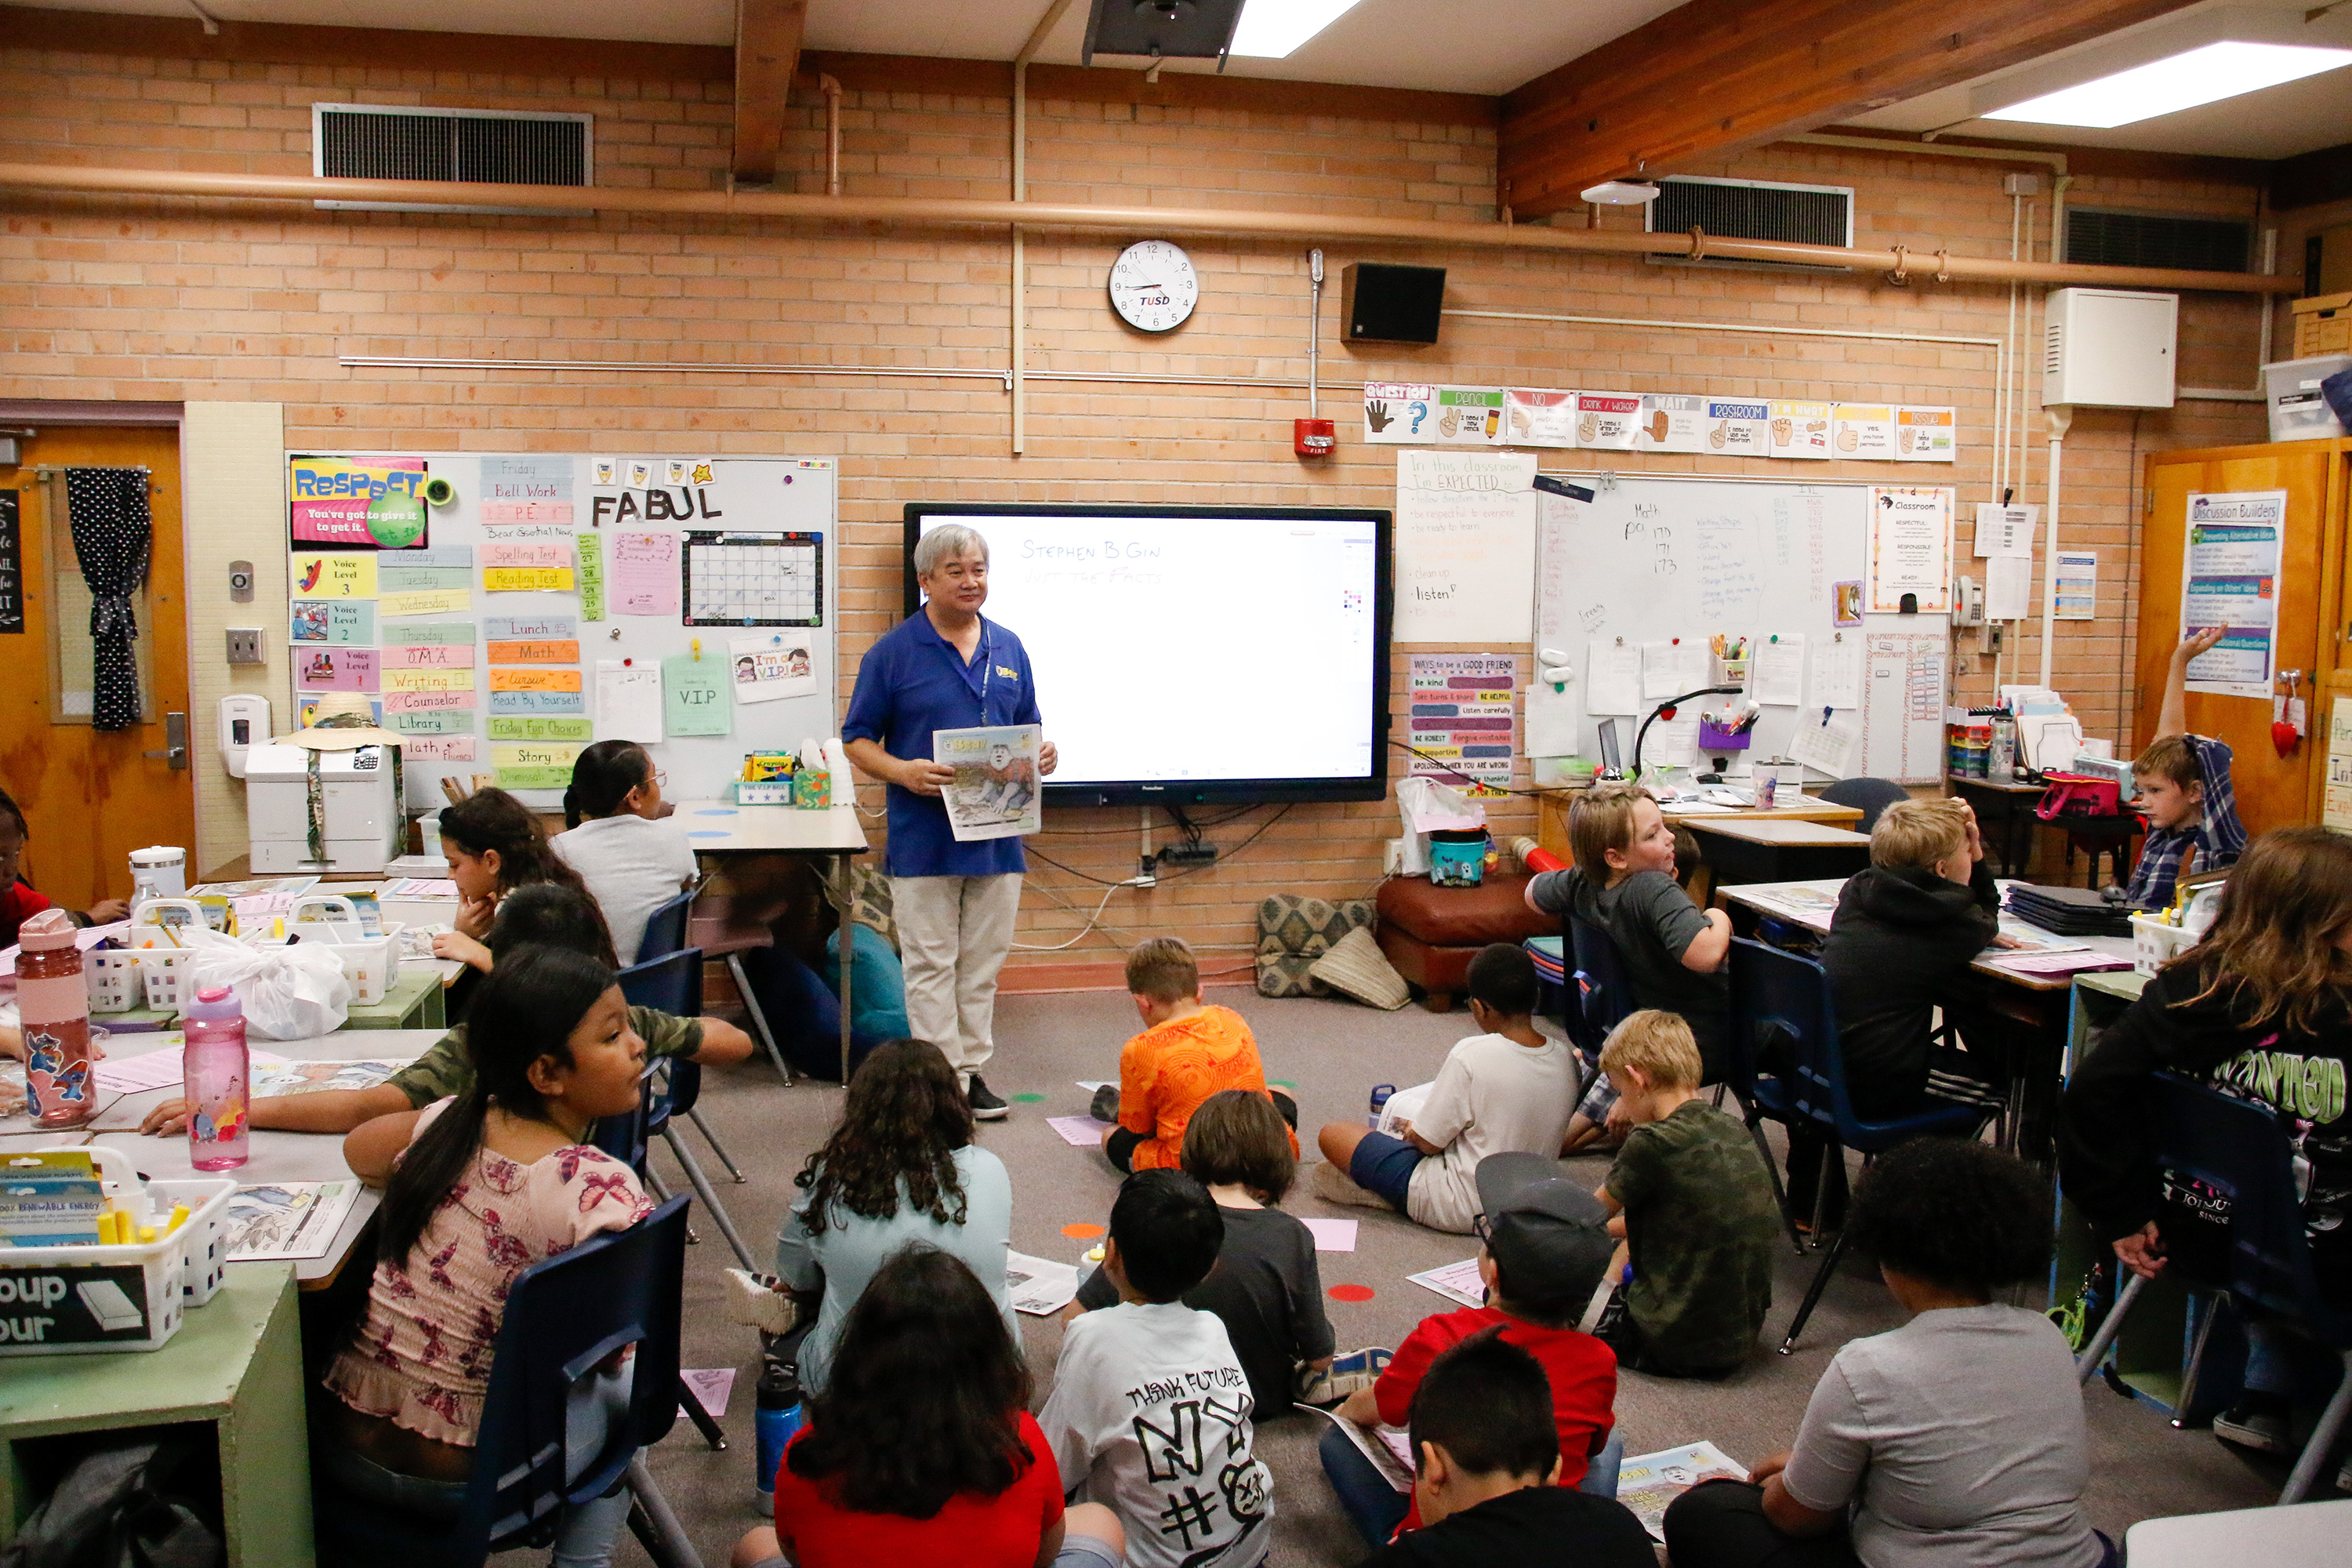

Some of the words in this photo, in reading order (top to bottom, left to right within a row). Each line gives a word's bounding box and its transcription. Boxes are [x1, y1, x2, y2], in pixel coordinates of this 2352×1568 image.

[1127, 251, 1138, 260] 11
[1147, 245, 1158, 254] 12
[1167, 250, 1173, 259] 1
[1116, 264, 1128, 274] 10
[1181, 263, 1188, 271] 2
[1115, 282, 1121, 291] 9
[1121, 302, 1127, 310] 8
[1139, 296, 1171, 306] TUSD
[1183, 299, 1189, 307] 4
[1134, 314, 1141, 323] 7
[1152, 318, 1160, 327] 6
[1171, 314, 1178, 322] 5
[1366, 384, 1430, 400] QUESTION
[1532, 393, 1546, 407] NO
[1654, 396, 1690, 410] WAIT
[501, 462, 538, 478] Friday
[1410, 454, 1425, 472] In
[1432, 454, 1456, 472] this
[1464, 454, 1523, 473] classroom
[1413, 474, 1432, 488] I'm
[1437, 474, 1499, 490] EXPECTED
[495, 484, 521, 497] Bell
[526, 484, 557, 497] Work
[592, 486, 723, 528] FABUL
[1635, 503, 1661, 520] Math
[1895, 500, 1936, 511] Classroom
[2193, 504, 2238, 521] Discussion
[2240, 503, 2276, 518] Builders
[307, 509, 345, 520] You've
[346, 510, 366, 522] got
[367, 510, 379, 521] to
[380, 510, 406, 523] give
[408, 510, 418, 521] it
[316, 523, 330, 532] to
[330, 523, 350, 534] get
[351, 522, 365, 533] it.
[1460, 520, 1480, 530] learn
[1624, 521, 1646, 542] pg
[485, 526, 514, 539] Bear
[555, 528, 573, 538] News
[495, 546, 534, 564] Spelling
[538, 546, 557, 561] Test
[1021, 539, 1095, 561] STEPHEN
[1104, 540, 1120, 559] B
[1126, 542, 1161, 558] GIN
[1655, 543, 1670, 555] 171
[394, 550, 436, 563] Monday
[333, 560, 358, 569] Voice
[1653, 558, 1677, 575] 173
[334, 570, 358, 580] Level
[399, 572, 439, 588] Tuesday
[496, 570, 535, 587] Reading
[538, 570, 558, 584] Test
[1109, 565, 1163, 585] FACTS
[1414, 566, 1437, 580] clean
[1439, 568, 1450, 580] up
[343, 583, 350, 596] 3
[334, 606, 358, 615] Voice
[398, 597, 450, 612] Wednesday
[334, 615, 358, 625] Level
[341, 630, 350, 641] 2
[401, 627, 445, 644] Thursday
[510, 622, 549, 635] Lunch
[346, 652, 369, 660] Voice
[519, 645, 555, 659] Math
[346, 662, 369, 672] Level
[756, 655, 777, 666] I'm
[1414, 661, 1435, 670] WAYS
[1463, 660, 1484, 670] GOOD
[1486, 660, 1513, 670] FRIEND
[358, 675, 364, 687] 1
[393, 673, 448, 691] Writing
[509, 672, 546, 685] Cursive
[404, 692, 461, 709] Counselor
[492, 693, 516, 706] Read
[521, 693, 535, 708] By
[539, 693, 580, 706] Yourself
[398, 716, 442, 732] Library
[492, 719, 523, 737] Friday
[527, 720, 544, 735] Fun
[548, 718, 583, 735] Choices
[409, 740, 438, 753] ath
[518, 750, 552, 766] Story
[1483, 775, 1510, 783] thankful
[19, 1201, 67, 1212] RENEWABLE
[70, 1202, 100, 1211] ENERGY
[0, 1273, 67, 1309] oup
[0, 1315, 56, 1342] our
[1125, 1377, 1186, 1408] THINK
[1185, 1367, 1247, 1393] FUTURE
